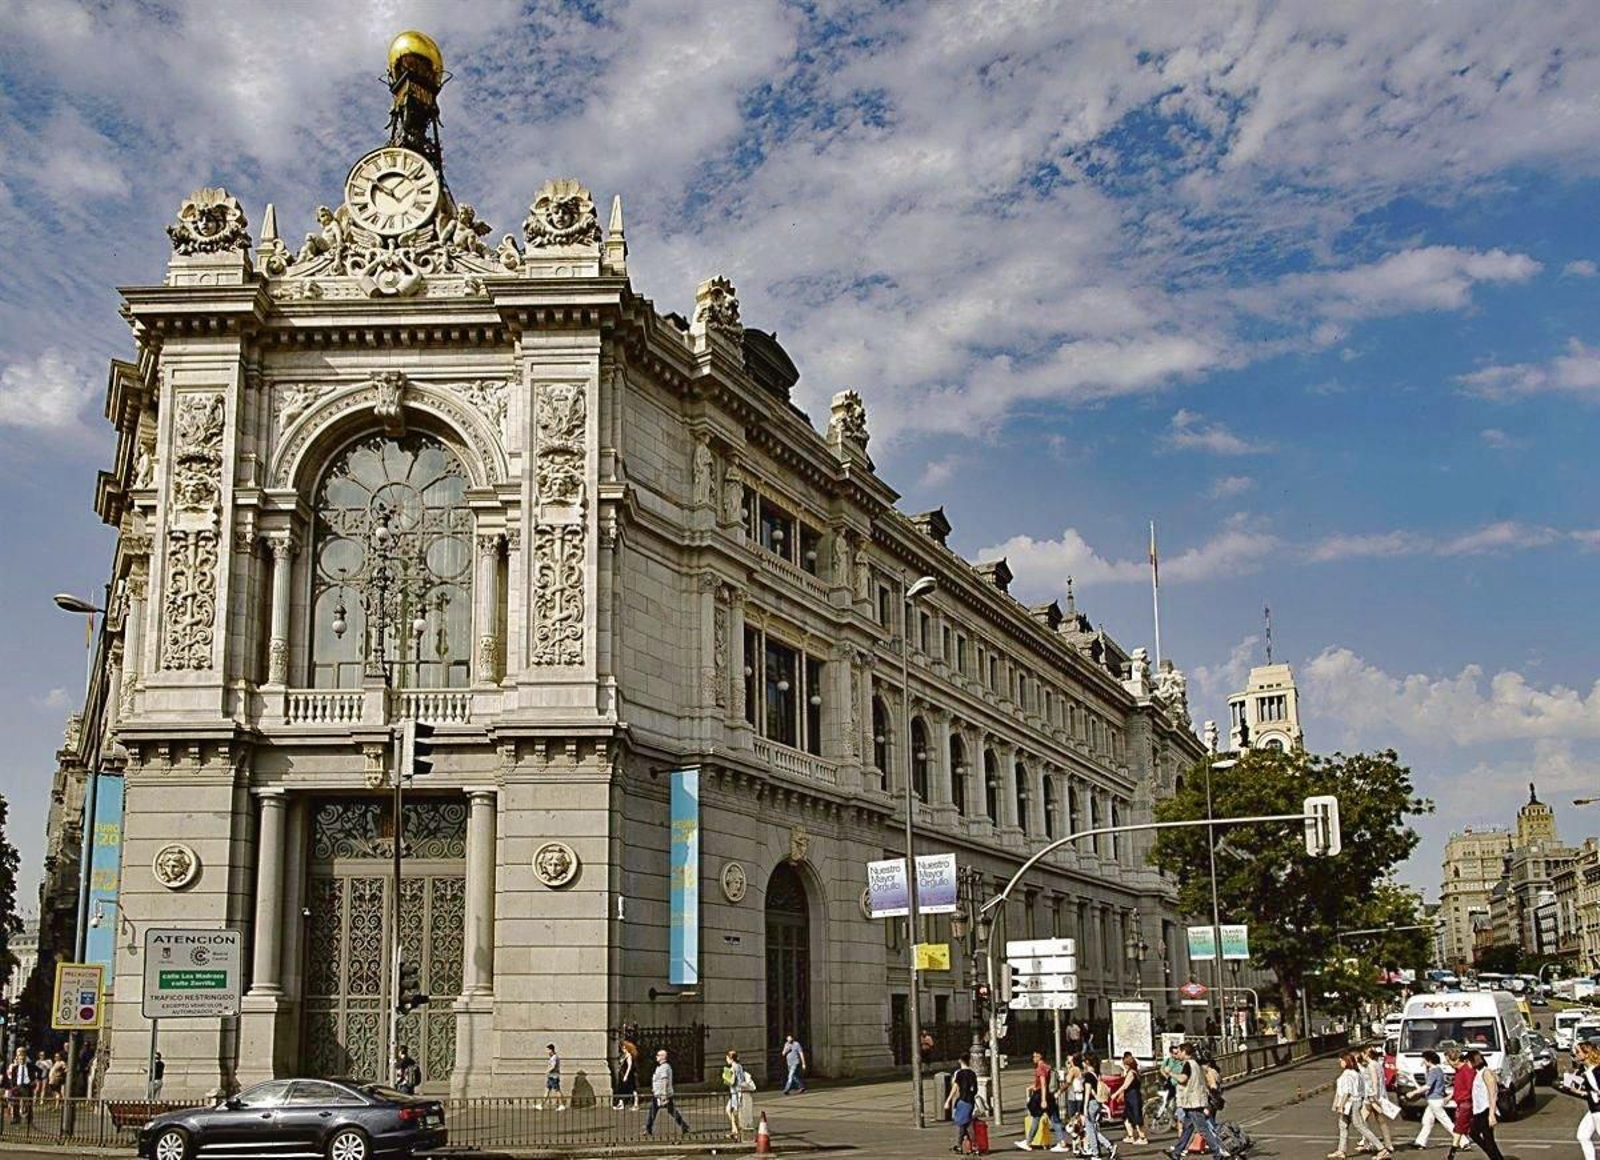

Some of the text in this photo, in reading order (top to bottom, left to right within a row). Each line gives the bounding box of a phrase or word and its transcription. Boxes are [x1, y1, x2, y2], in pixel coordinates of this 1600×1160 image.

[870, 864, 901, 875] Nuestro
[918, 859, 950, 870] Nuestro
[919, 868, 944, 878] Mayor
[871, 874, 895, 885] Mayor
[920, 877, 949, 888] Orgullo
[872, 882, 900, 892] Orgullo
[153, 934, 235, 945] ATENCIÓN
[1423, 1000, 1471, 1009] NACEX
